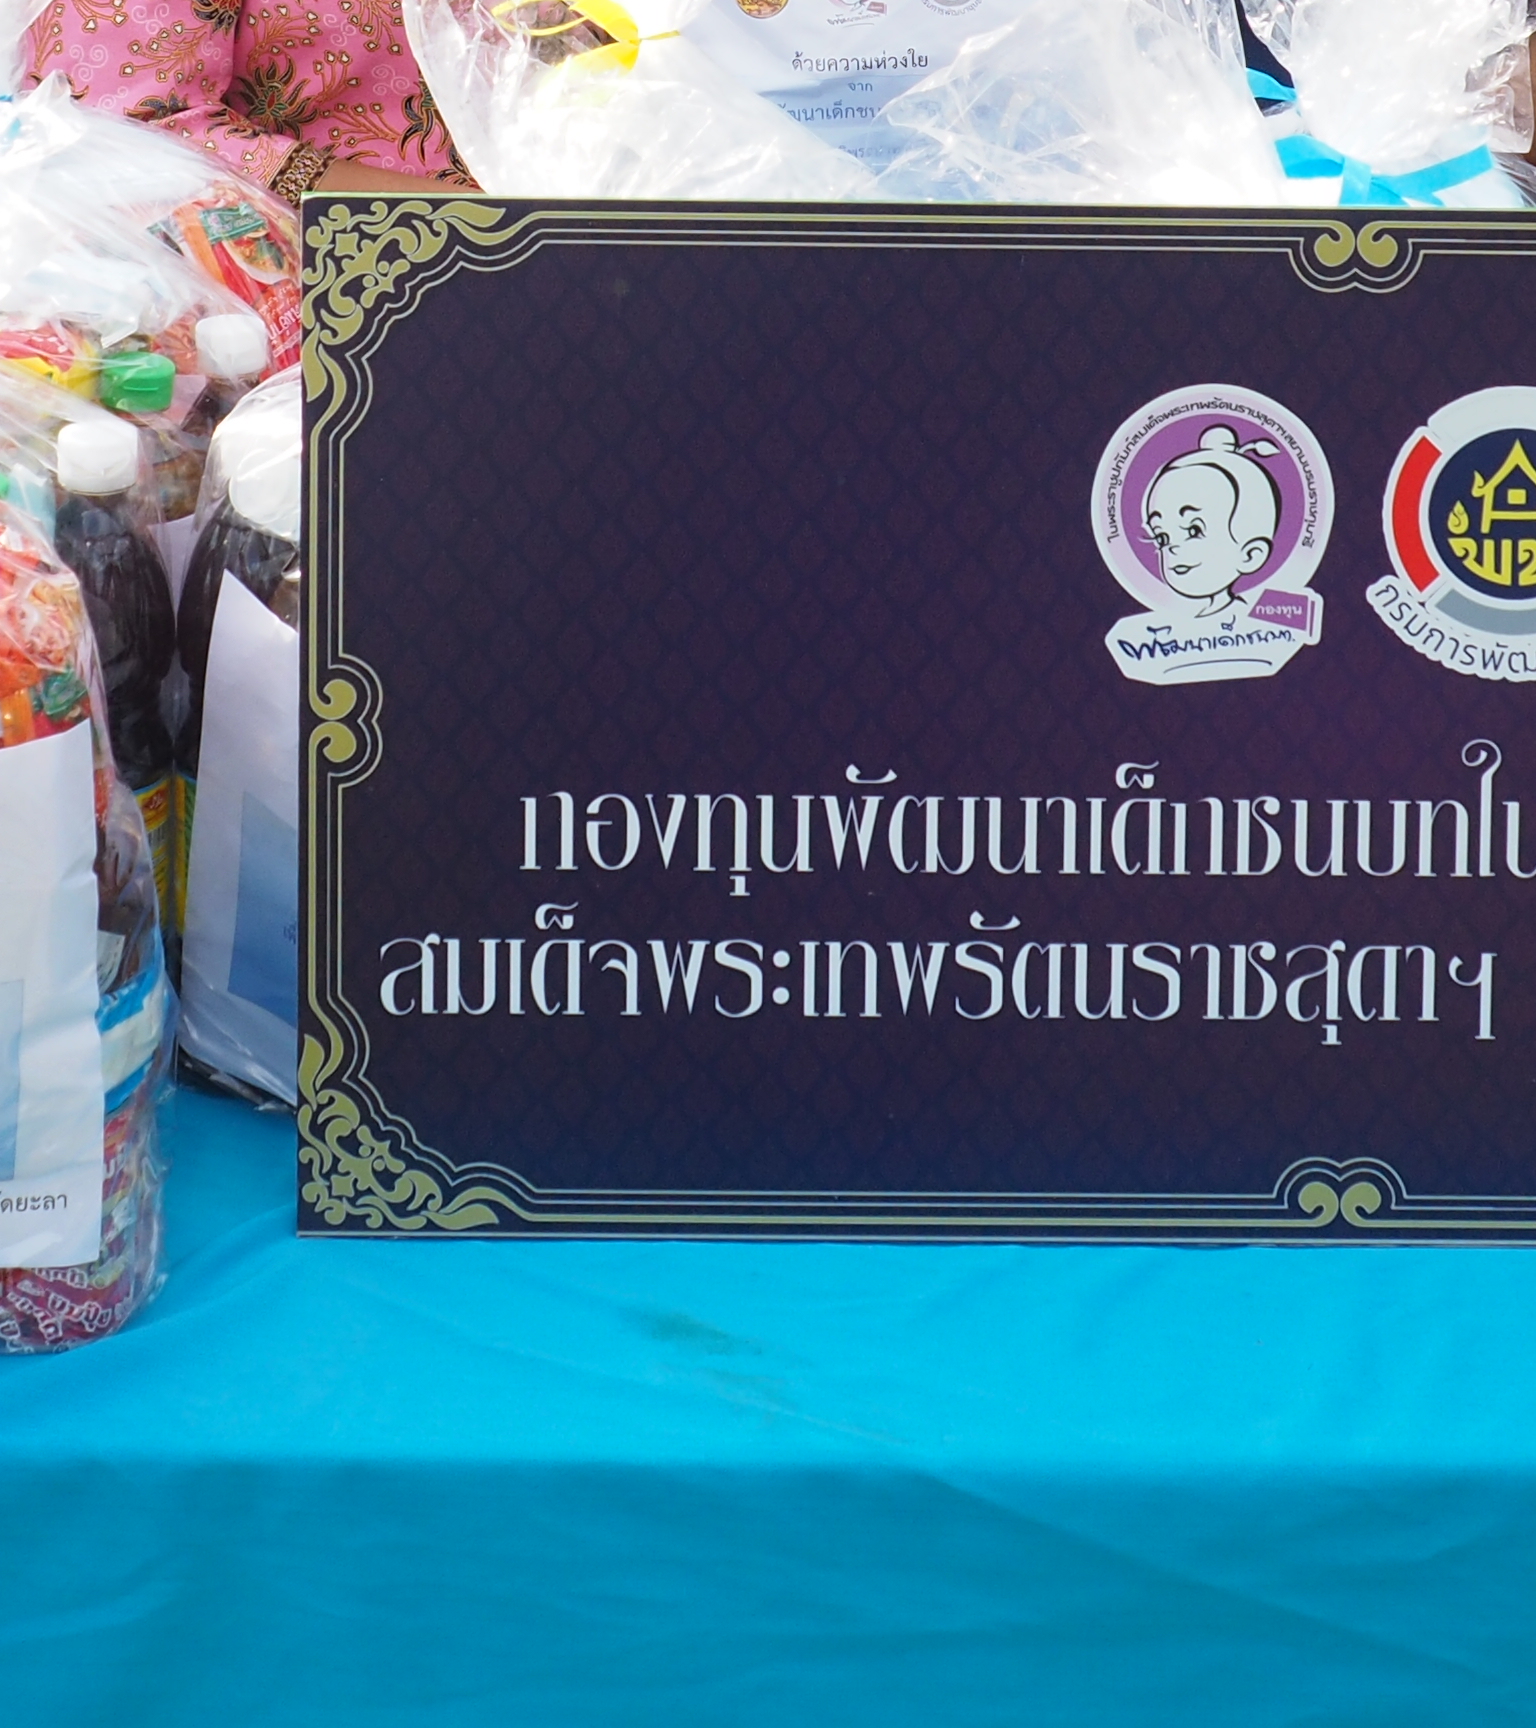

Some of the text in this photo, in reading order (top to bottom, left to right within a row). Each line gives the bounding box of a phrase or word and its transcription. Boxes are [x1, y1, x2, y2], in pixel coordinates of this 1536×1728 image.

[791, 48, 929, 72] ด้วยความห่วงใย
[847, 81, 874, 92] จาก
[1254, 602, 1303, 618] กองทุน
[378, 900, 1498, 1045] สมเด็จพระเทพรัตนราชสุดาฯ
